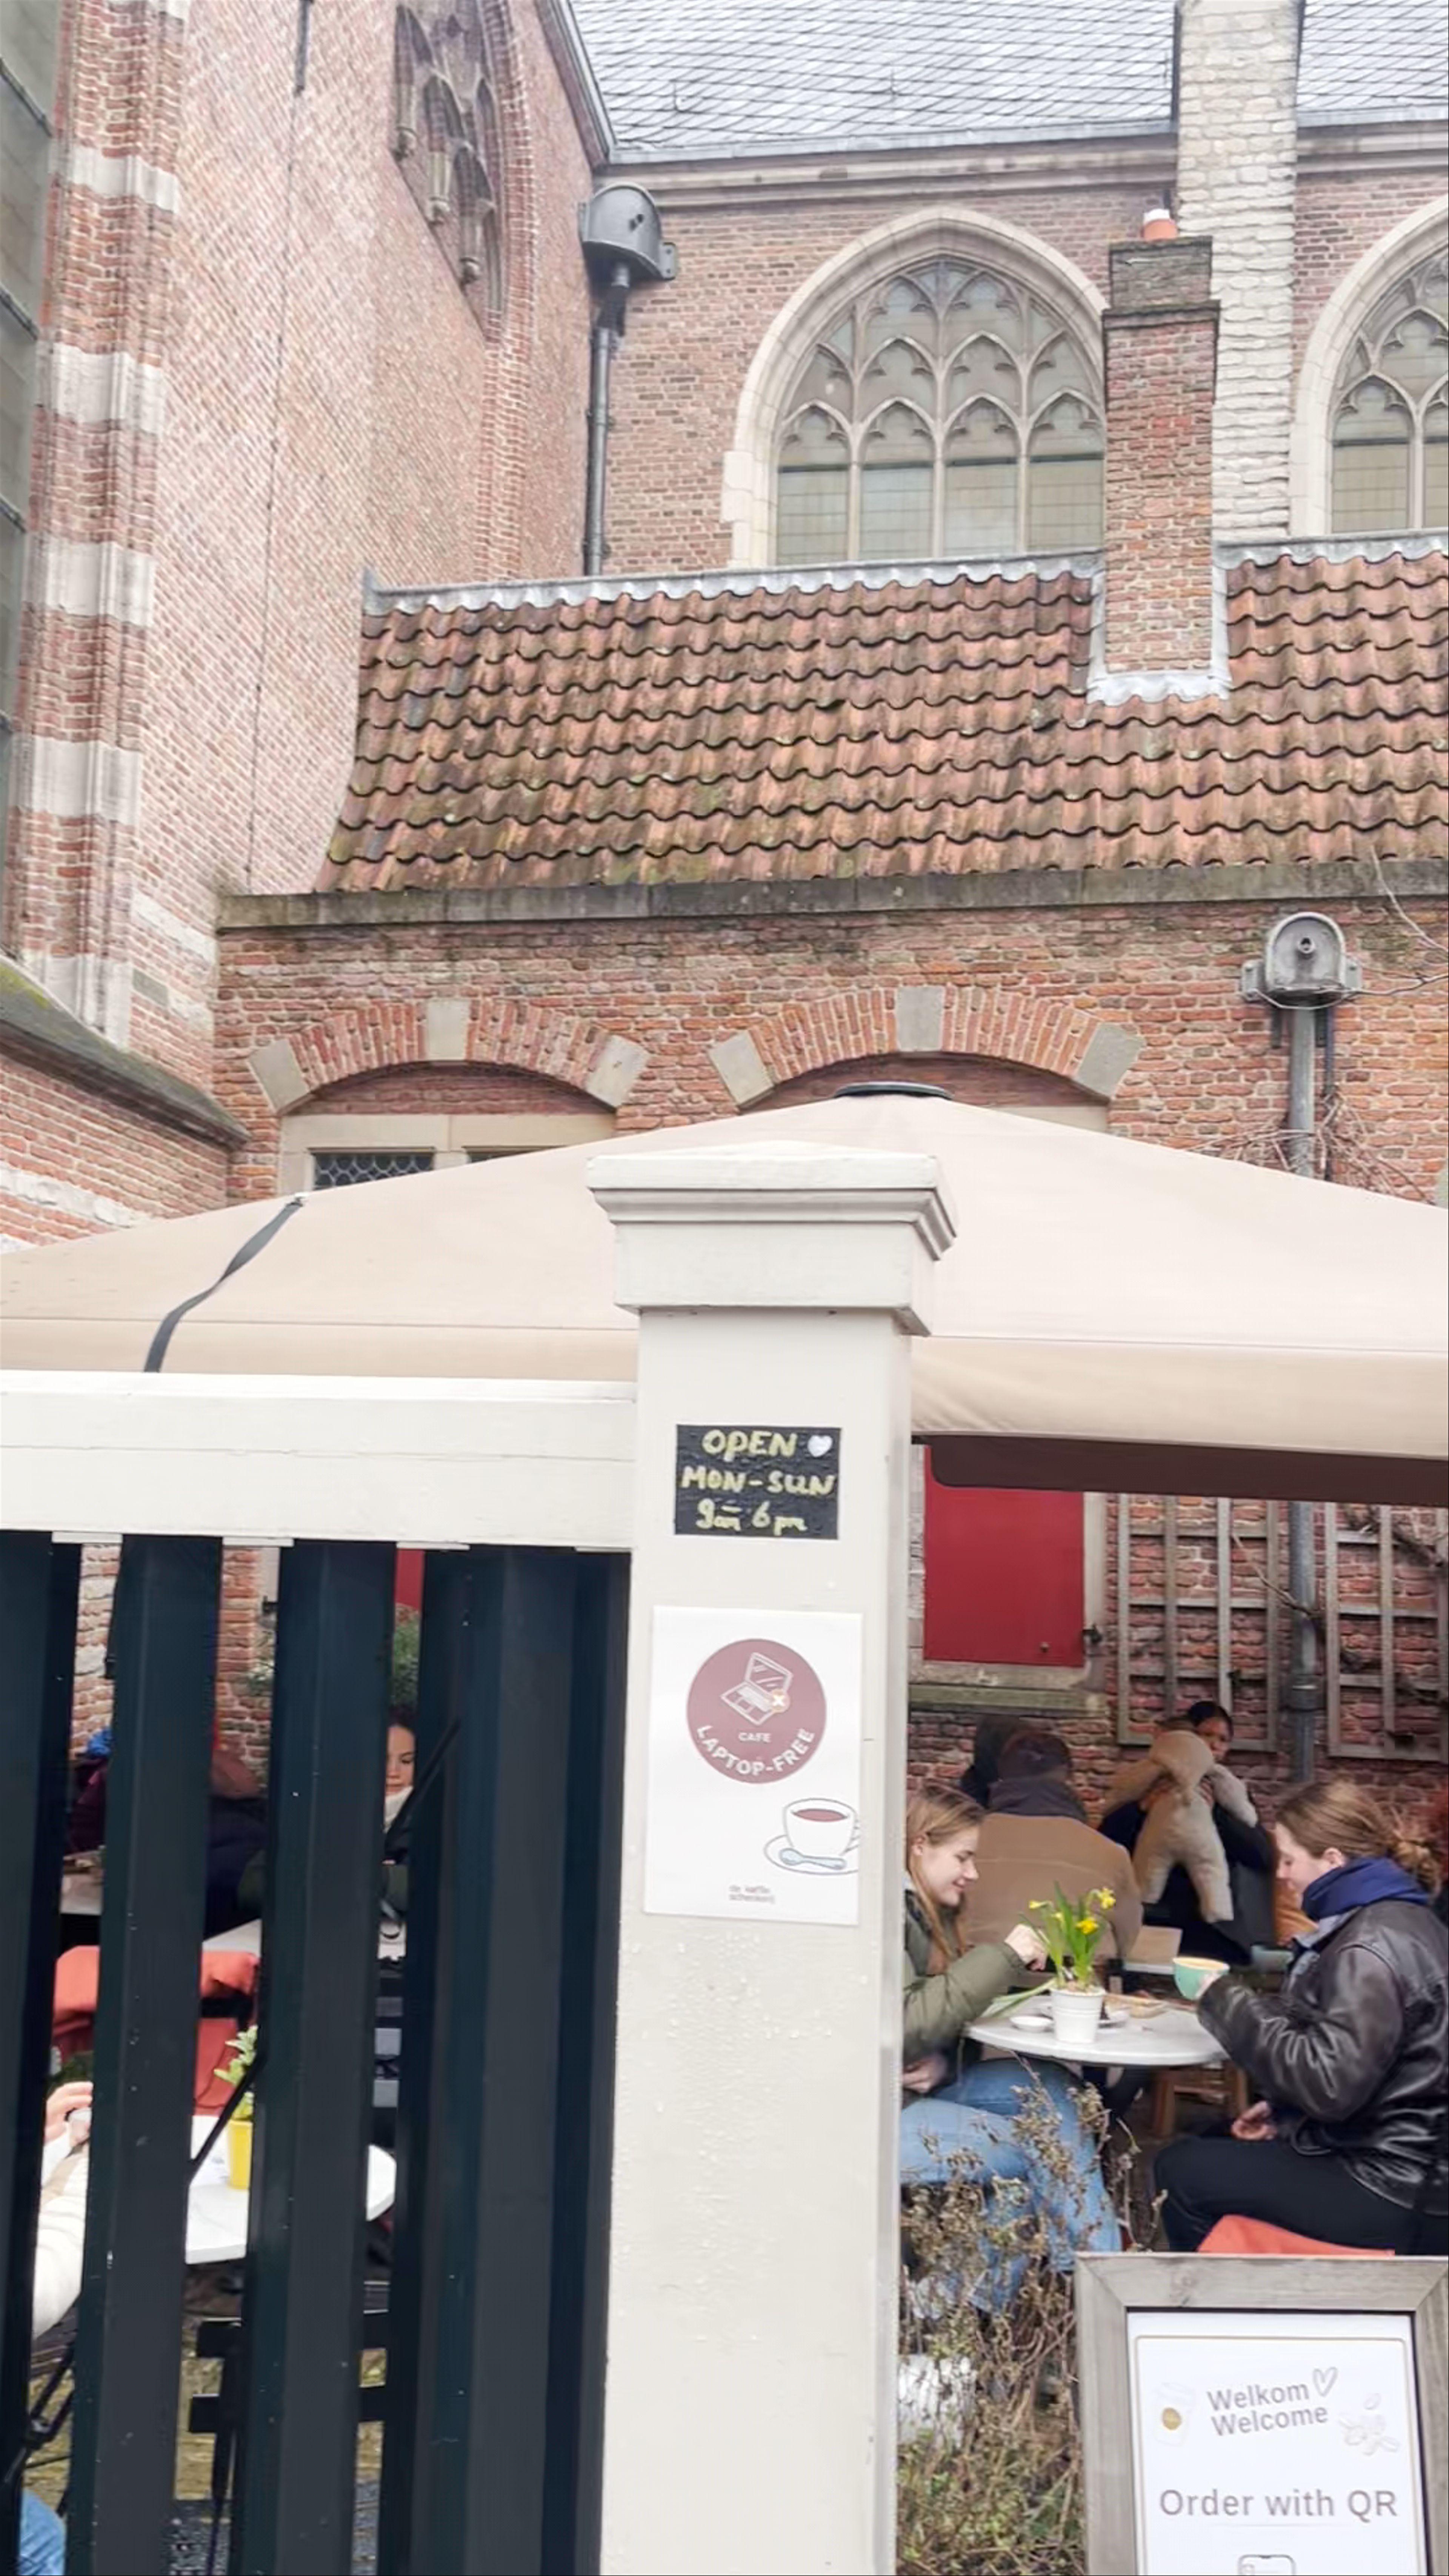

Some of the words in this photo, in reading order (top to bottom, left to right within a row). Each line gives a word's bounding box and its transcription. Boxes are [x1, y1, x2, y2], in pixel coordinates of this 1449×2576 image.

[701, 1429, 798, 1462] OPEN
[697, 1725, 815, 1775] LAPTOP-FREE
[738, 1732, 771, 1743] CAFE
[1207, 2382, 1310, 2411] Welkom
[1211, 2407, 1329, 2437] Welcome
[1160, 2489, 1254, 2516] Order
[1264, 2489, 1334, 2516] with
[1347, 2490, 1398, 2523] QR
